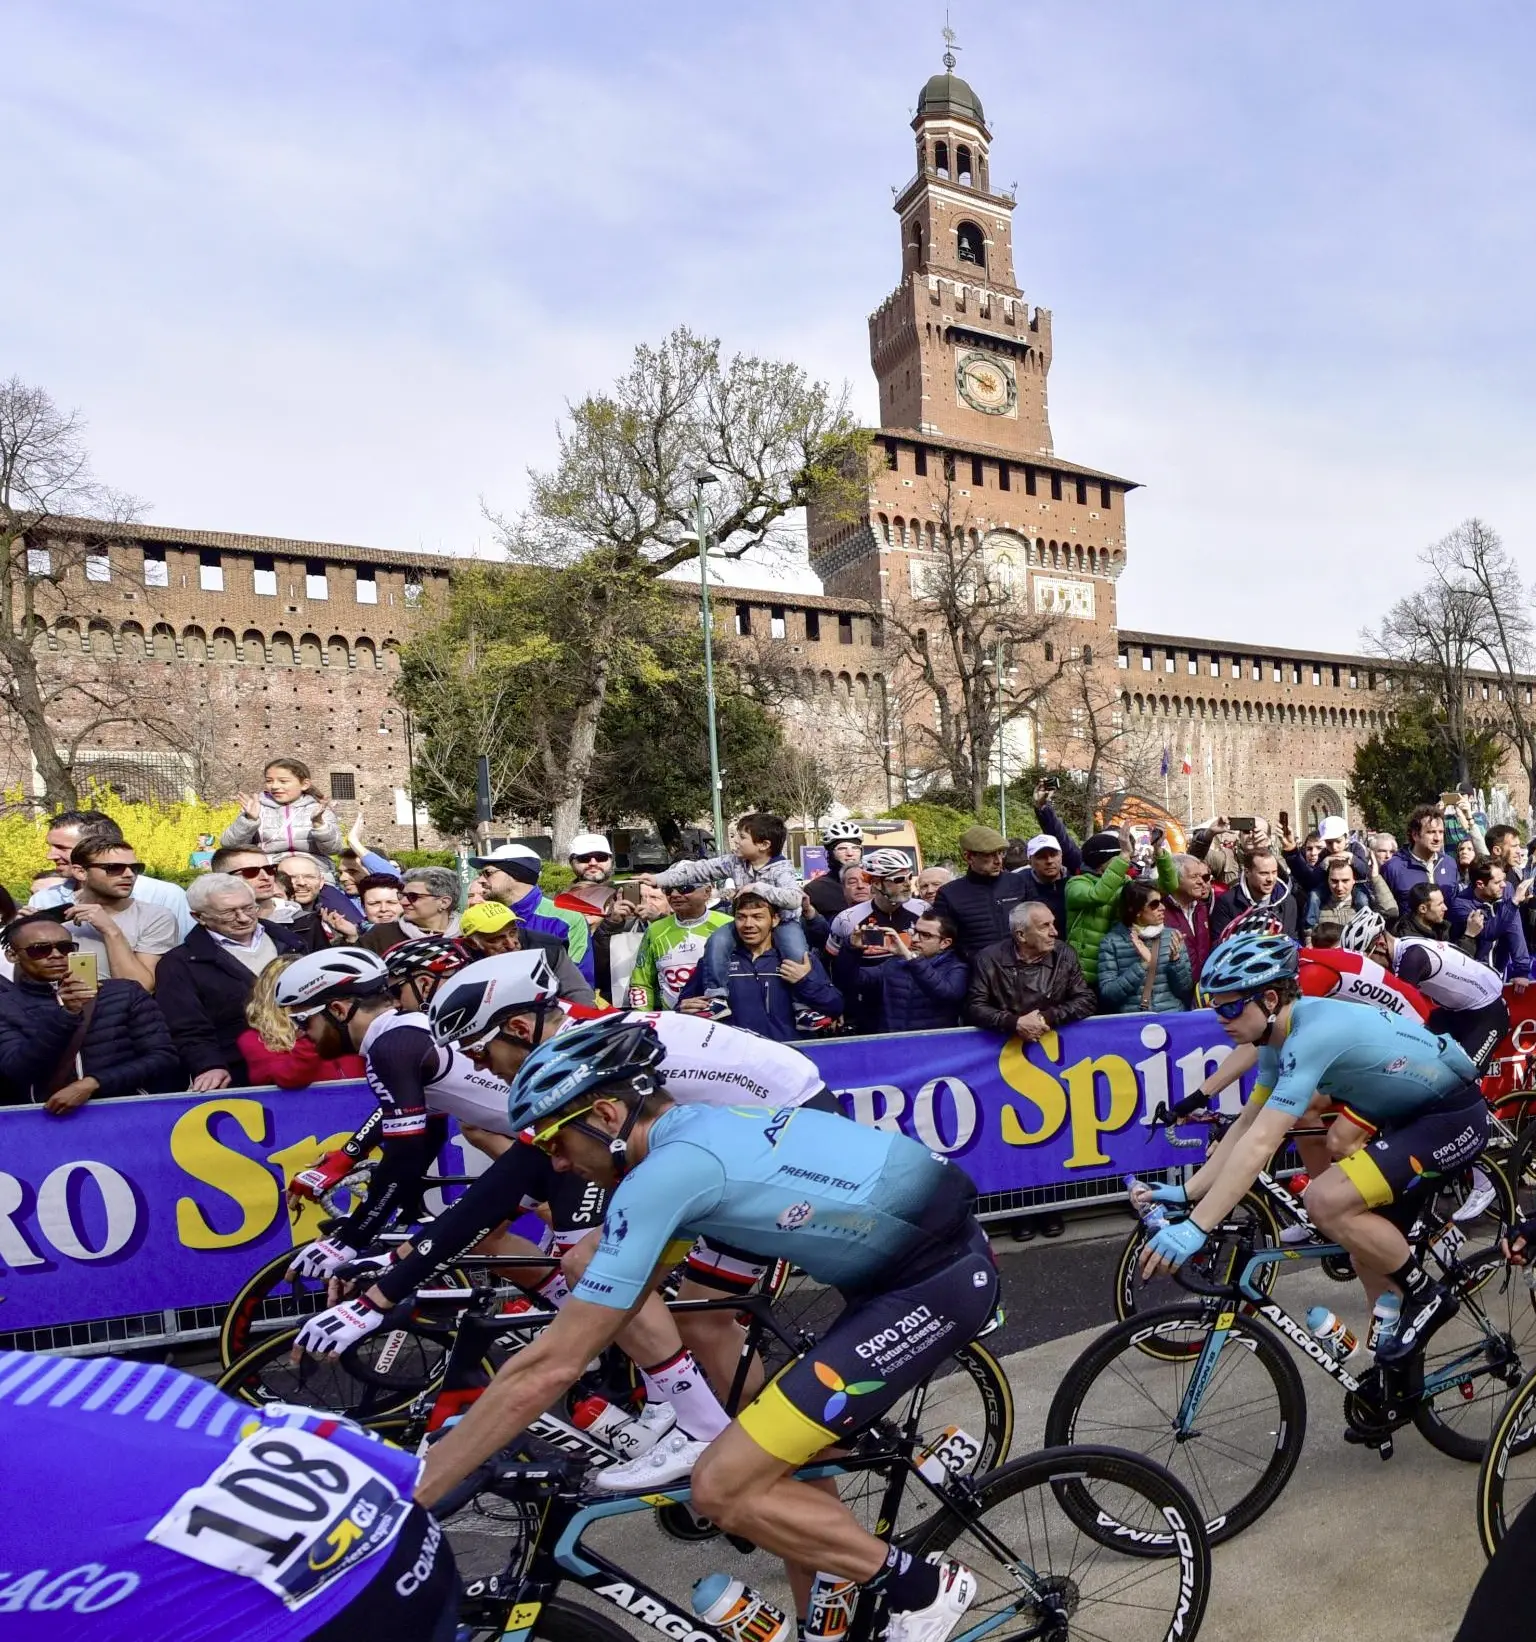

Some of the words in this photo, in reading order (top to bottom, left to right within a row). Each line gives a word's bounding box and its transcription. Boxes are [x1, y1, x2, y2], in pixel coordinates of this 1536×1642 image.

[299, 974, 326, 993] GIANT
[1349, 979, 1406, 1016] SOUDAL
[448, 1020, 478, 1040] GIANT
[464, 1073, 511, 1095] #CREATI
[660, 1069, 769, 1099] REATINGMEMORIES
[355, 1107, 384, 1142] SOUDA
[833, 1075, 978, 1154] RO
[1433, 1143, 1456, 1160] EXPO
[1454, 1126, 1475, 1147] 2017
[374, 1182, 398, 1212] Sunweb
[778, 1164, 829, 1187] PREMIER
[829, 1177, 860, 1193] TECH
[447, 1227, 491, 1265] Sunweb
[855, 1326, 900, 1361] EXPO
[894, 1304, 934, 1336] 2017
[875, 1341, 907, 1367] Future
[904, 1316, 941, 1350] Energy
[880, 1350, 912, 1378] Astana
[908, 1319, 957, 1360] Kazakhstan
[1260, 1304, 1339, 1374] ARGON
[1336, 1365, 1361, 1393] 18
[376, 1330, 405, 1374] Sunwe
[185, 1440, 350, 1569] 108
